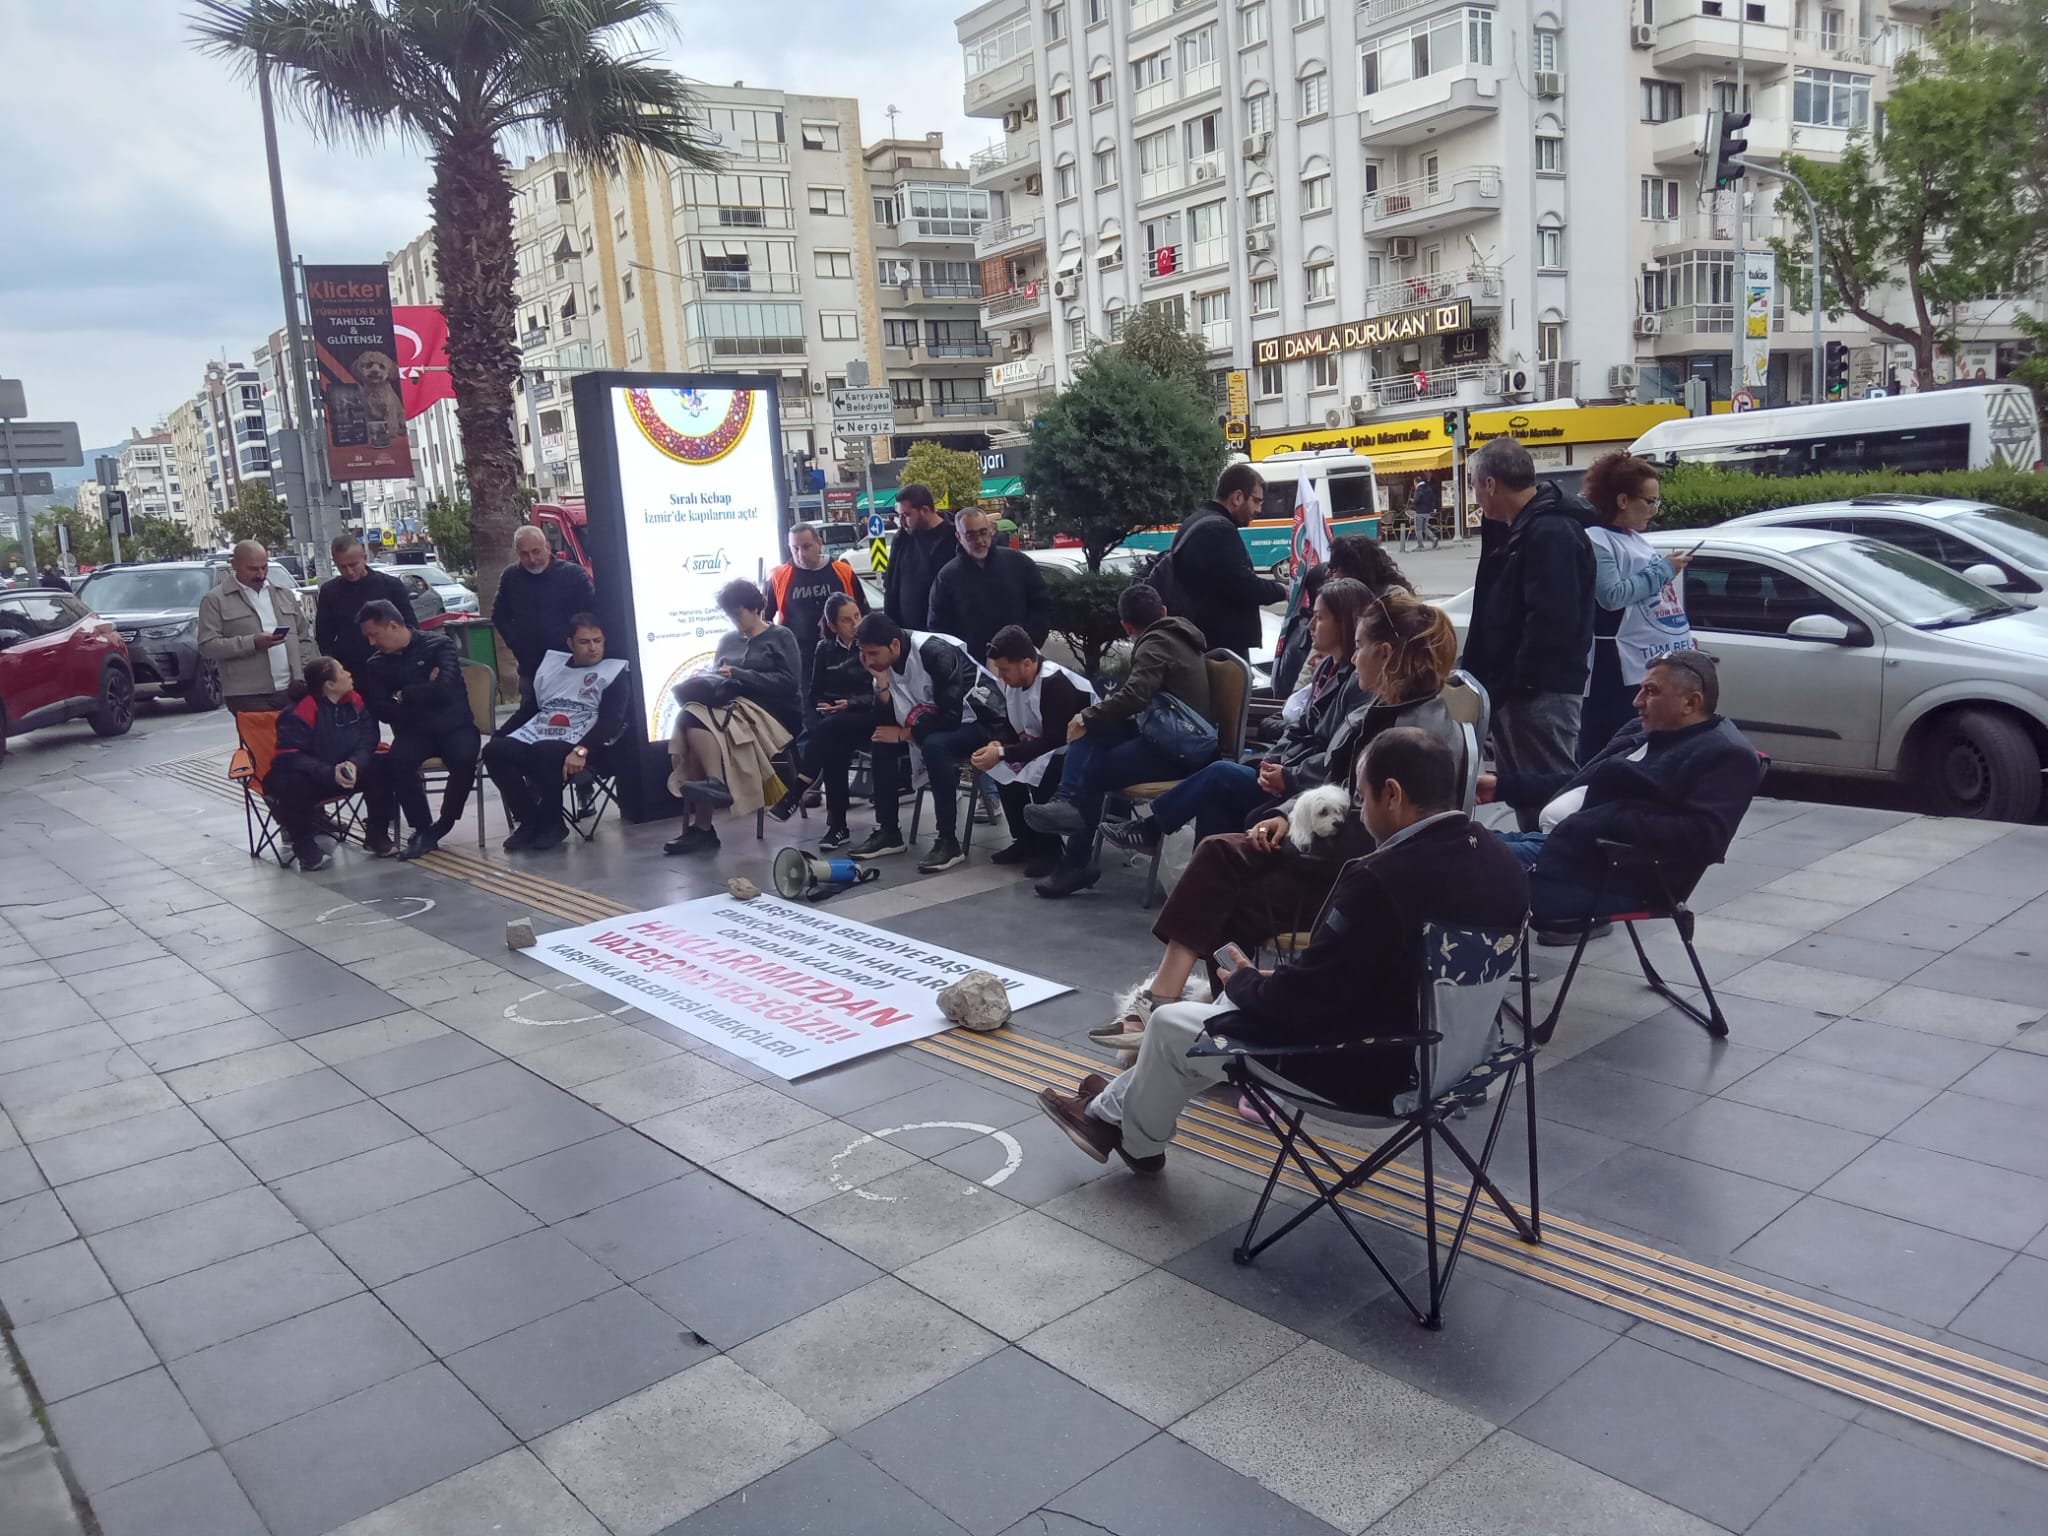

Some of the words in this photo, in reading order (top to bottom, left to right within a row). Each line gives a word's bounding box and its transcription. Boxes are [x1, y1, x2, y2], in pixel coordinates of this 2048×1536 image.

[309, 280, 385, 299] Klicker
[329, 317, 376, 326] TAHILSIZ
[327, 333, 384, 345] GLÜTENSİZ
[350, 326, 358, 335] &
[1284, 332, 1340, 358] DAMLA
[1344, 314, 1425, 348] DURUKAN
[845, 391, 890, 401] Karşıyaka
[846, 402, 890, 413] Belediyesi
[847, 421, 890, 434] Nergiz
[1350, 434, 1376, 449] Unlu
[669, 491, 698, 505] Sıralı
[700, 491, 732, 506] Kebap
[644, 508, 686, 524] İzmir'de
[688, 508, 736, 524] kapılarını
[737, 507, 758, 521] açtı!
[1640, 642, 1670, 659] TÜM
[712, 908, 825, 947] EMEKÇİLERİN
[818, 941, 865, 961] TÜM
[741, 899, 838, 932] KARŞIYAKA
[833, 926, 929, 960] BELEDİYE
[917, 955, 1025, 991] BAŞNI
[716, 928, 801, 958] ORTADAN
[794, 952, 895, 991] KALDIRDI
[627, 920, 914, 1028] HAKLARIMIZDAN
[547, 943, 625, 978] KARŞIYAKA
[616, 973, 713, 1014] BELEDİYESİ
[694, 1007, 811, 1058] EMEKÇİLERİ
